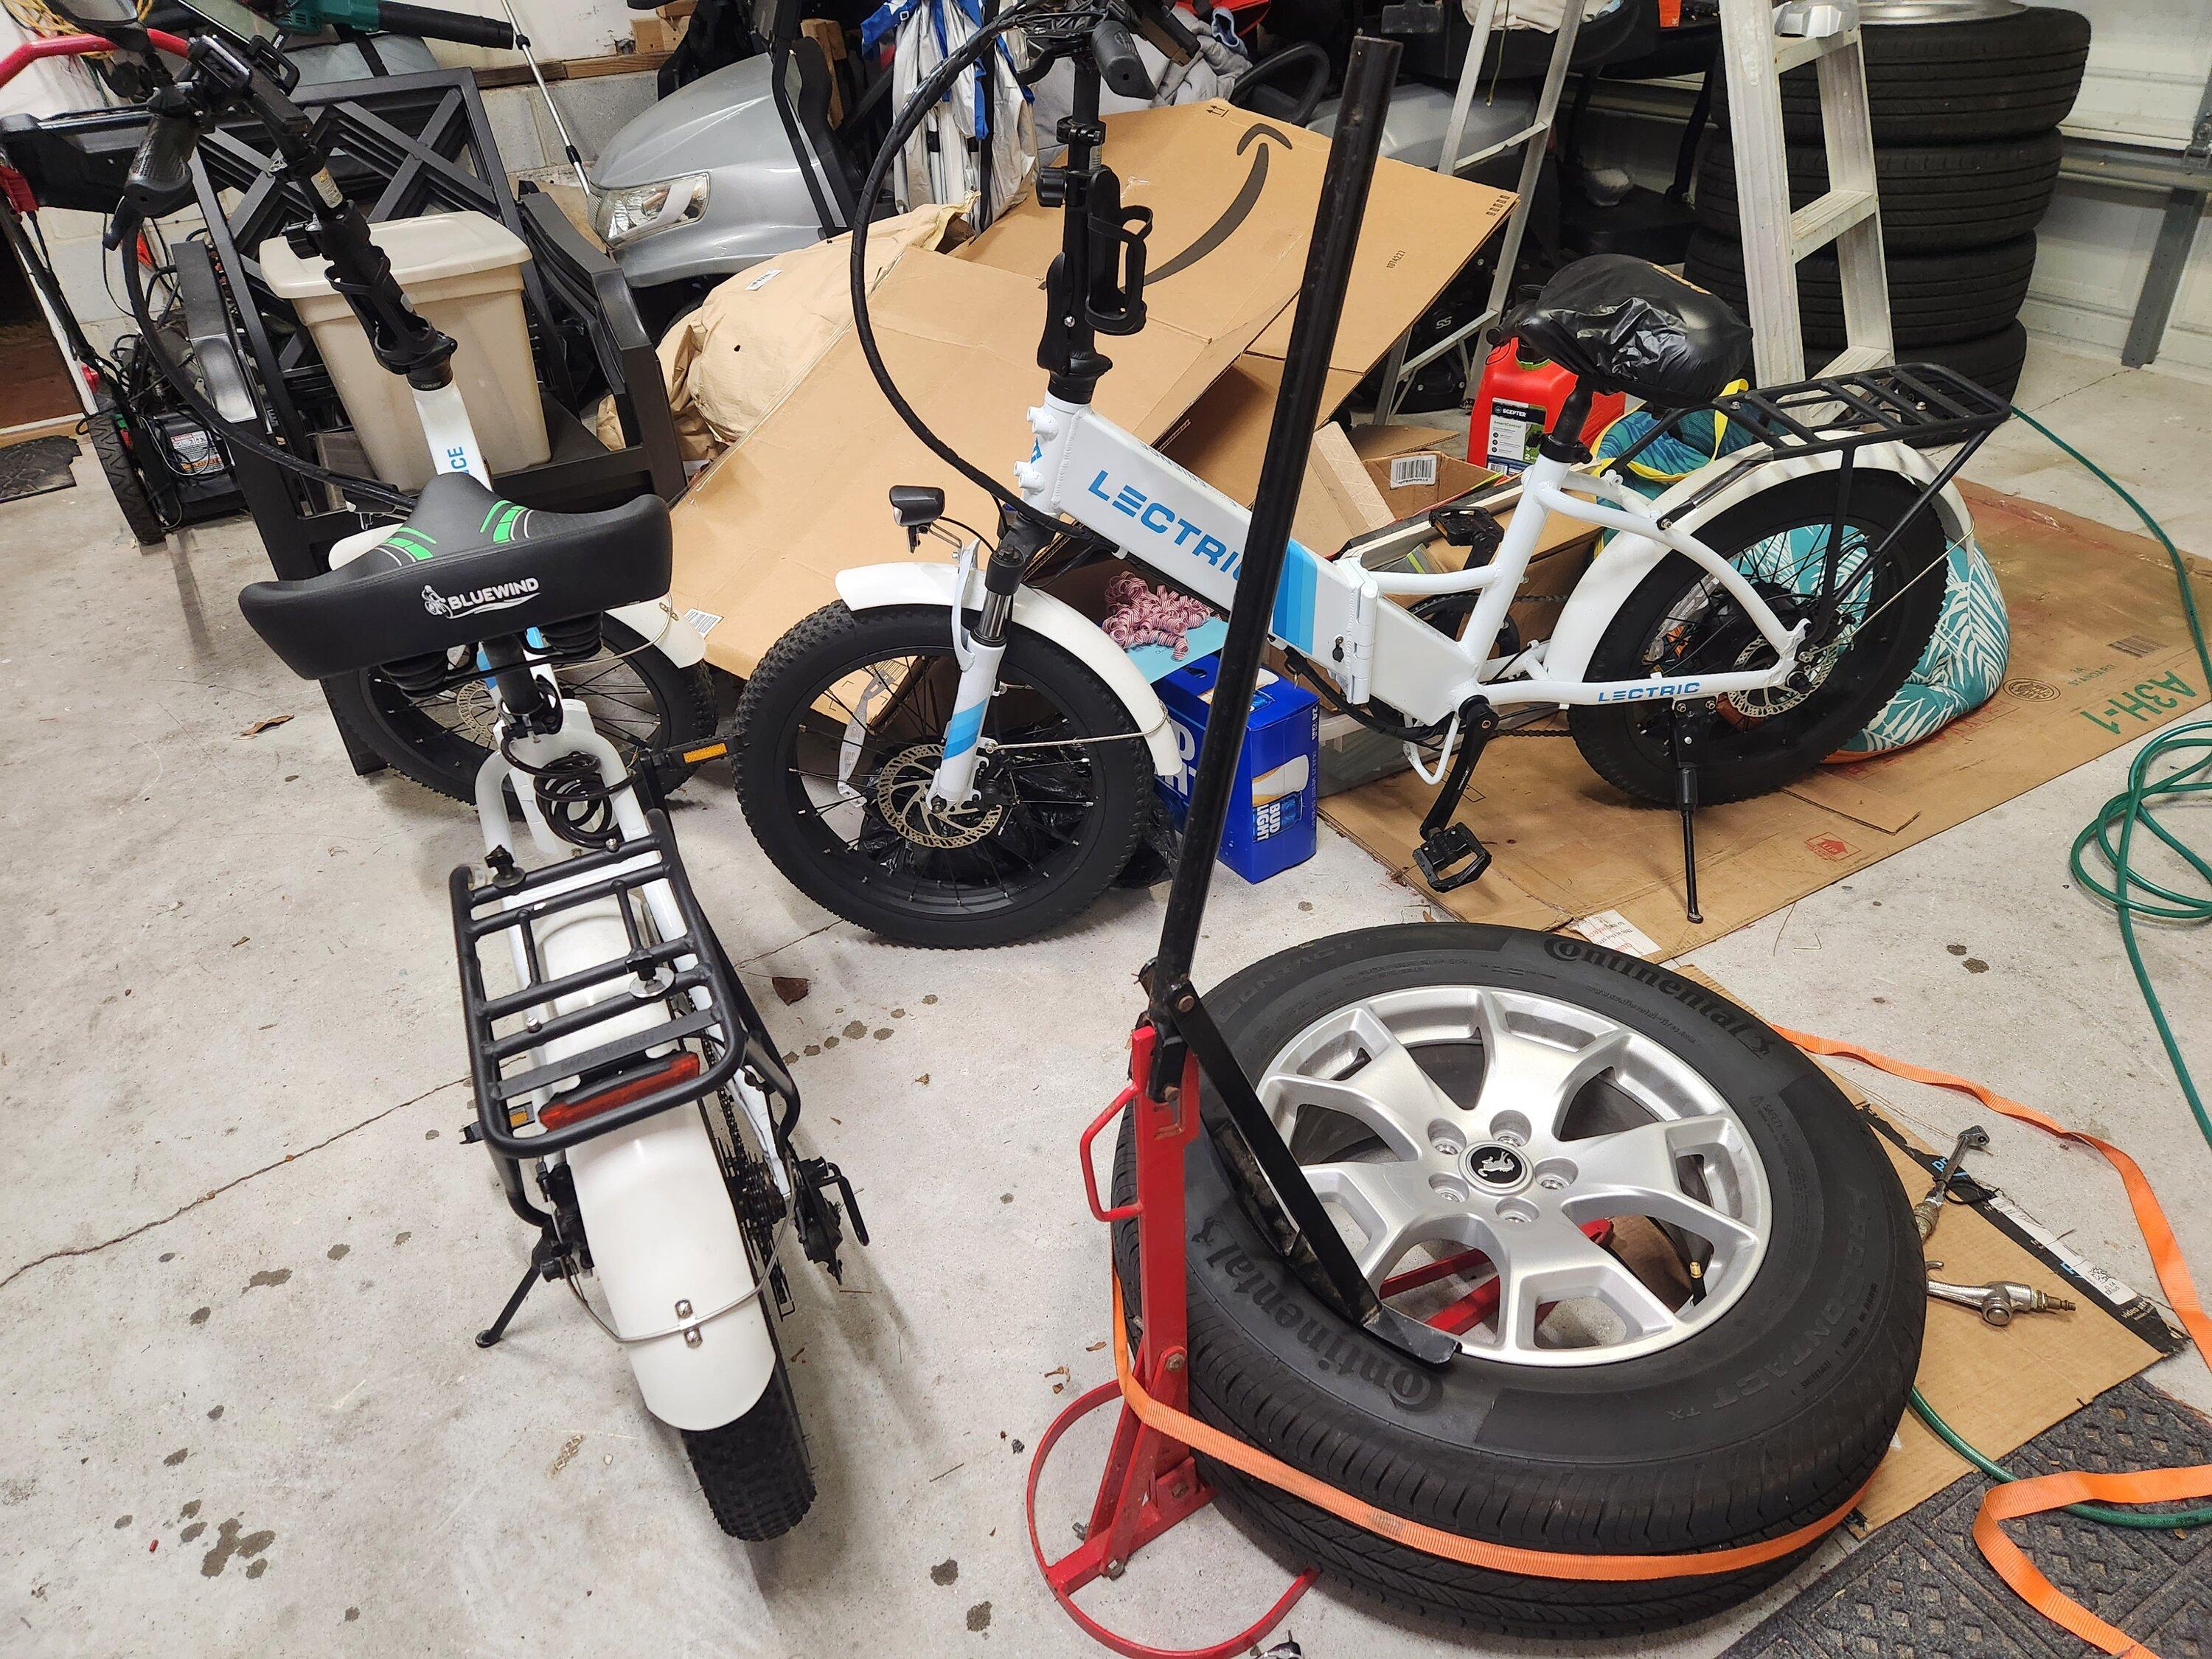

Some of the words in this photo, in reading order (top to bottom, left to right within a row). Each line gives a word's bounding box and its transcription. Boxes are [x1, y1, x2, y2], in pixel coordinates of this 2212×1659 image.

[1502, 408, 1526, 417] SCEPTER
[1088, 469, 1242, 581] LECTRI
[447, 577, 539, 611] BLUEWIND
[1598, 682, 1700, 702] LECTRIC
[2080, 670, 2197, 734] A3H-1
[1256, 804, 1270, 841] LIGHT
[1269, 802, 1281, 834] BUD
[1543, 937, 1755, 1036] Continental
[1206, 1242, 1443, 1413] Continental
